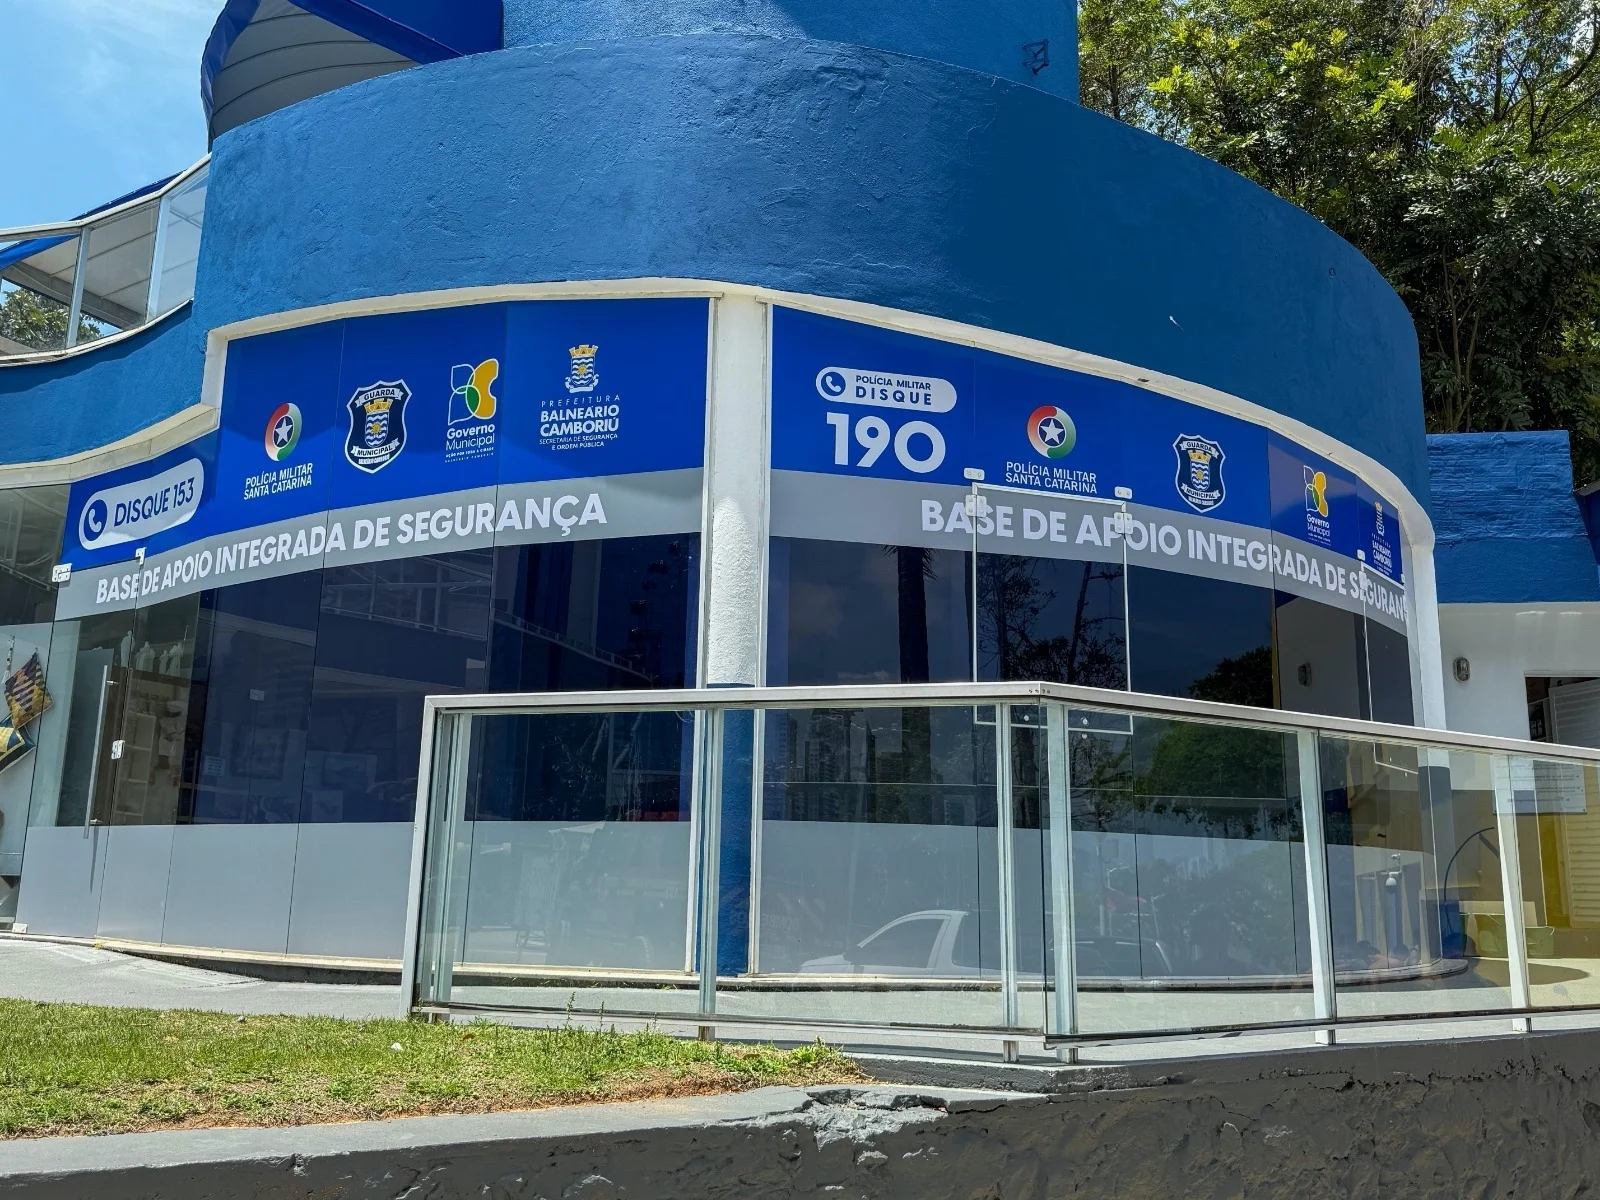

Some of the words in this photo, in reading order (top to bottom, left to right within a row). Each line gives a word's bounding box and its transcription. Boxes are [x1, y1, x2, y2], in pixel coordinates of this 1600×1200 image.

[855, 375, 893, 387] POLÍCIA
[896, 379, 932, 391] MILITAR
[363, 388, 395, 401] GUARDA
[541, 394, 620, 408] PREFEITURA
[855, 385, 932, 406] DISQUE
[540, 404, 620, 423] BALNEÁRIO
[446, 423, 496, 440] Governo
[540, 417, 619, 437] CAMBORIÚ
[445, 432, 495, 451] Municipal
[539, 437, 573, 445] SECRETARIA
[582, 433, 618, 441] SEGURANÇA
[826, 411, 946, 474] 190
[1186, 441, 1213, 452] GUARDA
[356, 444, 394, 457] MUNICIPAL
[245, 470, 277, 489] POLÍCIA
[279, 462, 313, 481] MILITAR
[1006, 461, 1050, 477] POLÍCIA
[1053, 467, 1097, 483] MILITAR
[243, 484, 270, 500] SANTA
[271, 474, 312, 494] CATARINA
[1005, 472, 1041, 487] SANTA
[1044, 477, 1098, 494] CATARINA
[114, 487, 171, 527] DISQUE
[172, 477, 195, 509] 153
[1185, 487, 1216, 499] MUNICIPAL
[1306, 513, 1330, 529] Governo
[95, 572, 139, 604] BASE
[140, 566, 161, 596] DE
[161, 550, 213, 590] APOIO
[215, 522, 347, 575] INTEGRADA
[353, 516, 391, 550] DE
[396, 493, 608, 545] SEGURANÇA
[921, 499, 1014, 538] BASE
[1022, 508, 1068, 543] DE
[1075, 514, 1182, 556] APOIO
[1187, 528, 1323, 588] INTEGRADA
[1324, 562, 1347, 596] DE
